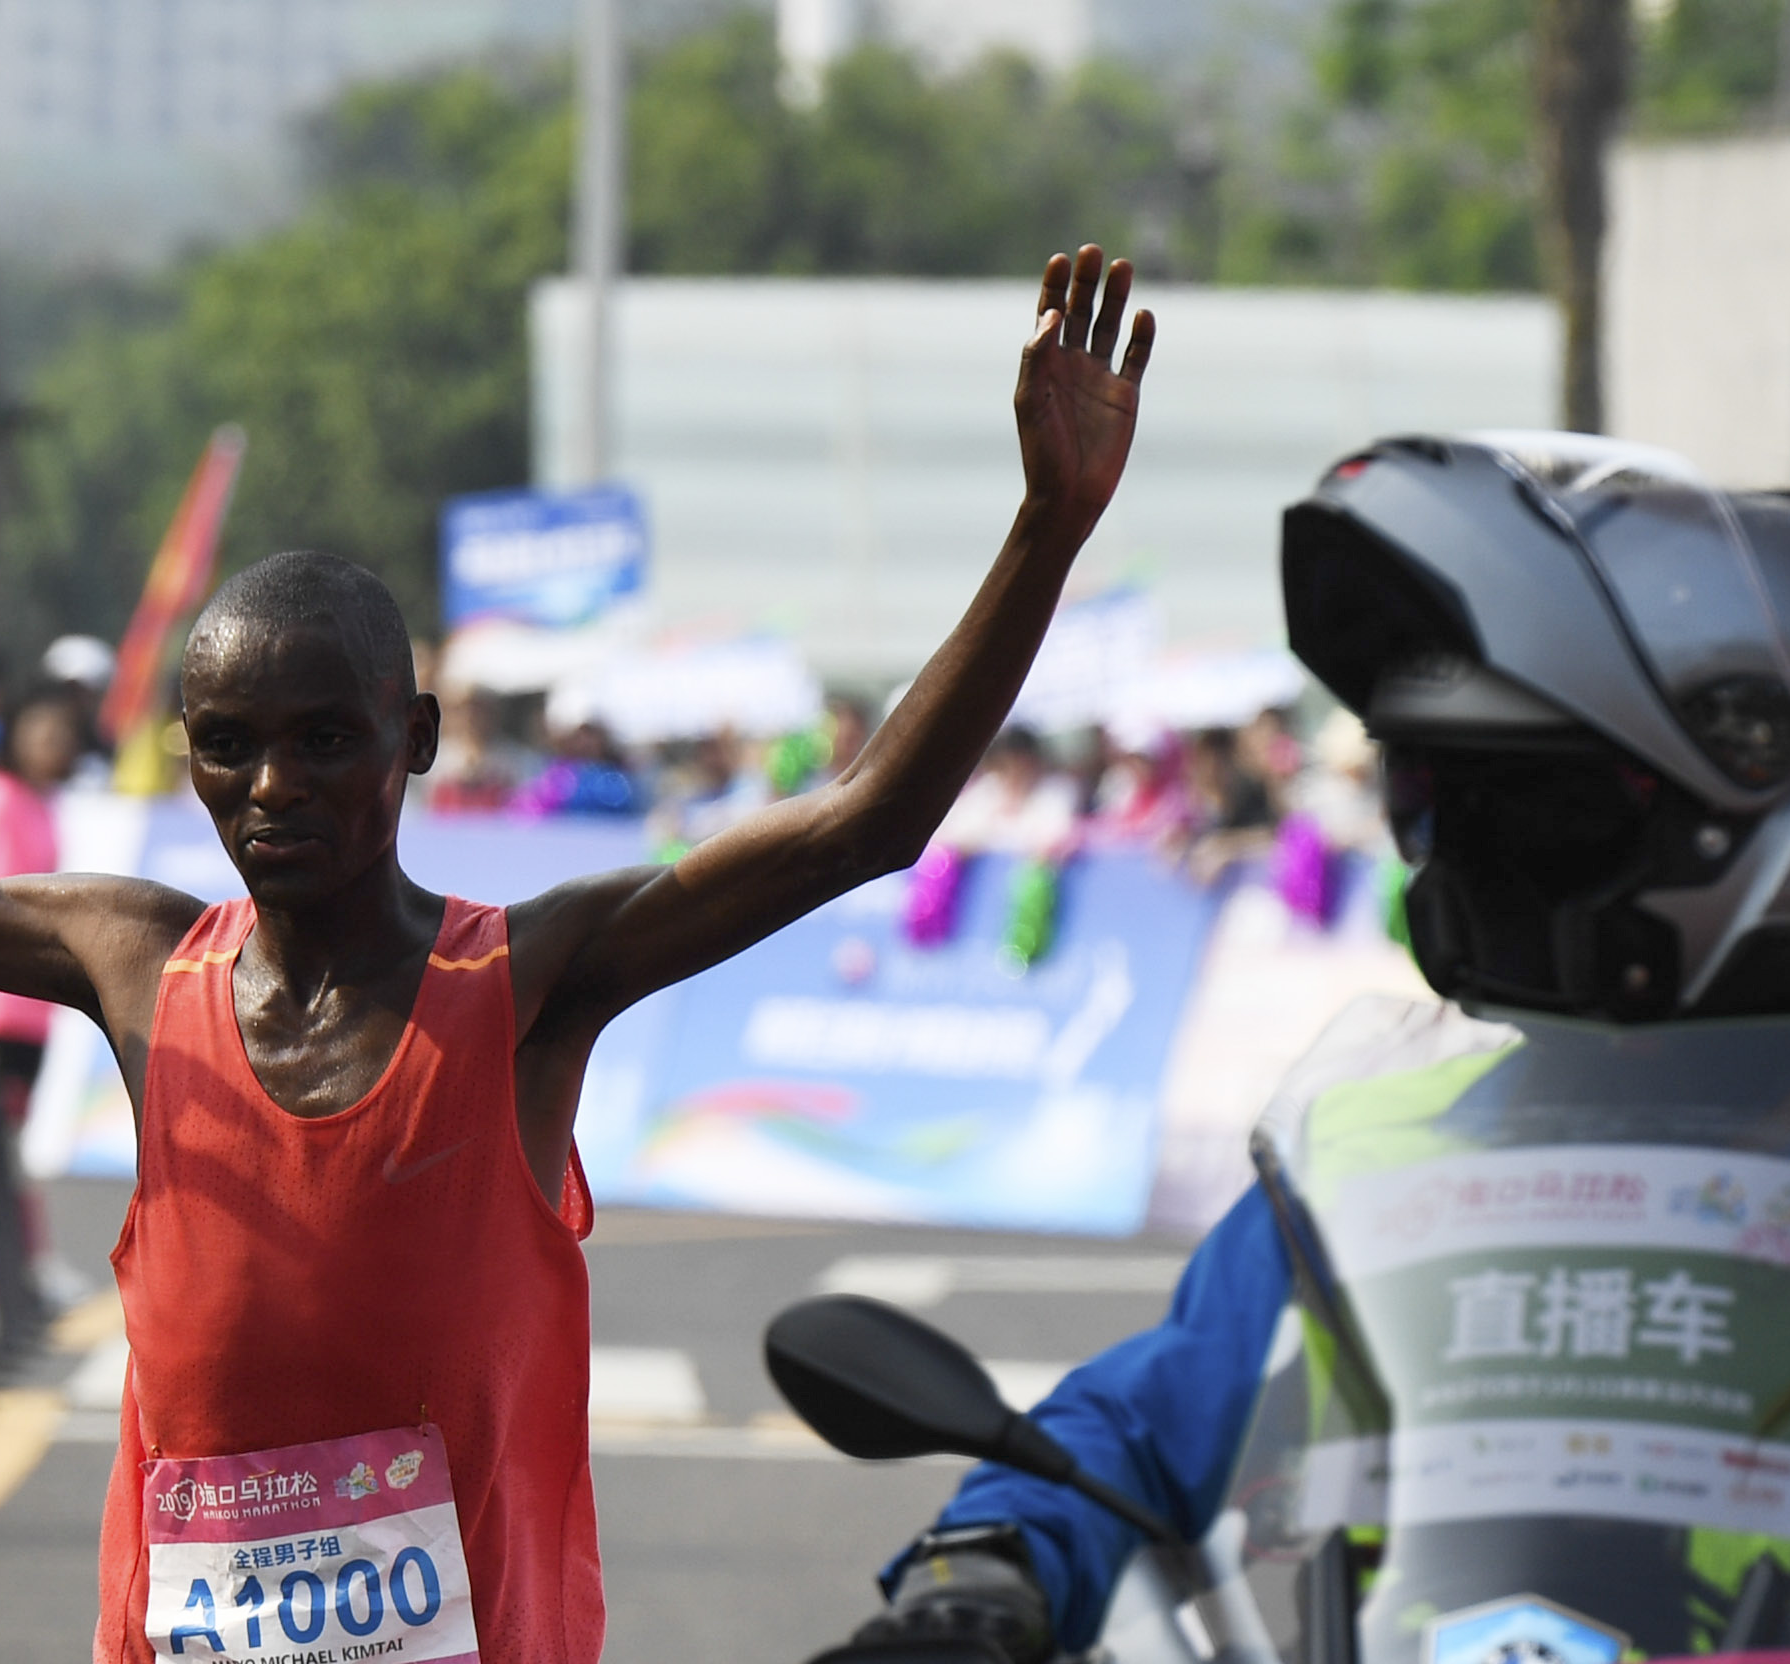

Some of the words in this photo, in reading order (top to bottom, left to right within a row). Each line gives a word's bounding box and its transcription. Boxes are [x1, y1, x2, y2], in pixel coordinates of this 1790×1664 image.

[1445, 1266, 1737, 1365] 直播车
[156, 1492, 192, 1513] 2019
[198, 1470, 319, 1508] 海口马拉松
[203, 1509, 239, 1521] HAIKOU
[243, 1496, 322, 1519] MARATHON
[233, 1535, 343, 1570] 全程男子组
[170, 1545, 442, 1655] A1000
[342, 1637, 404, 1662] KIMTAI
